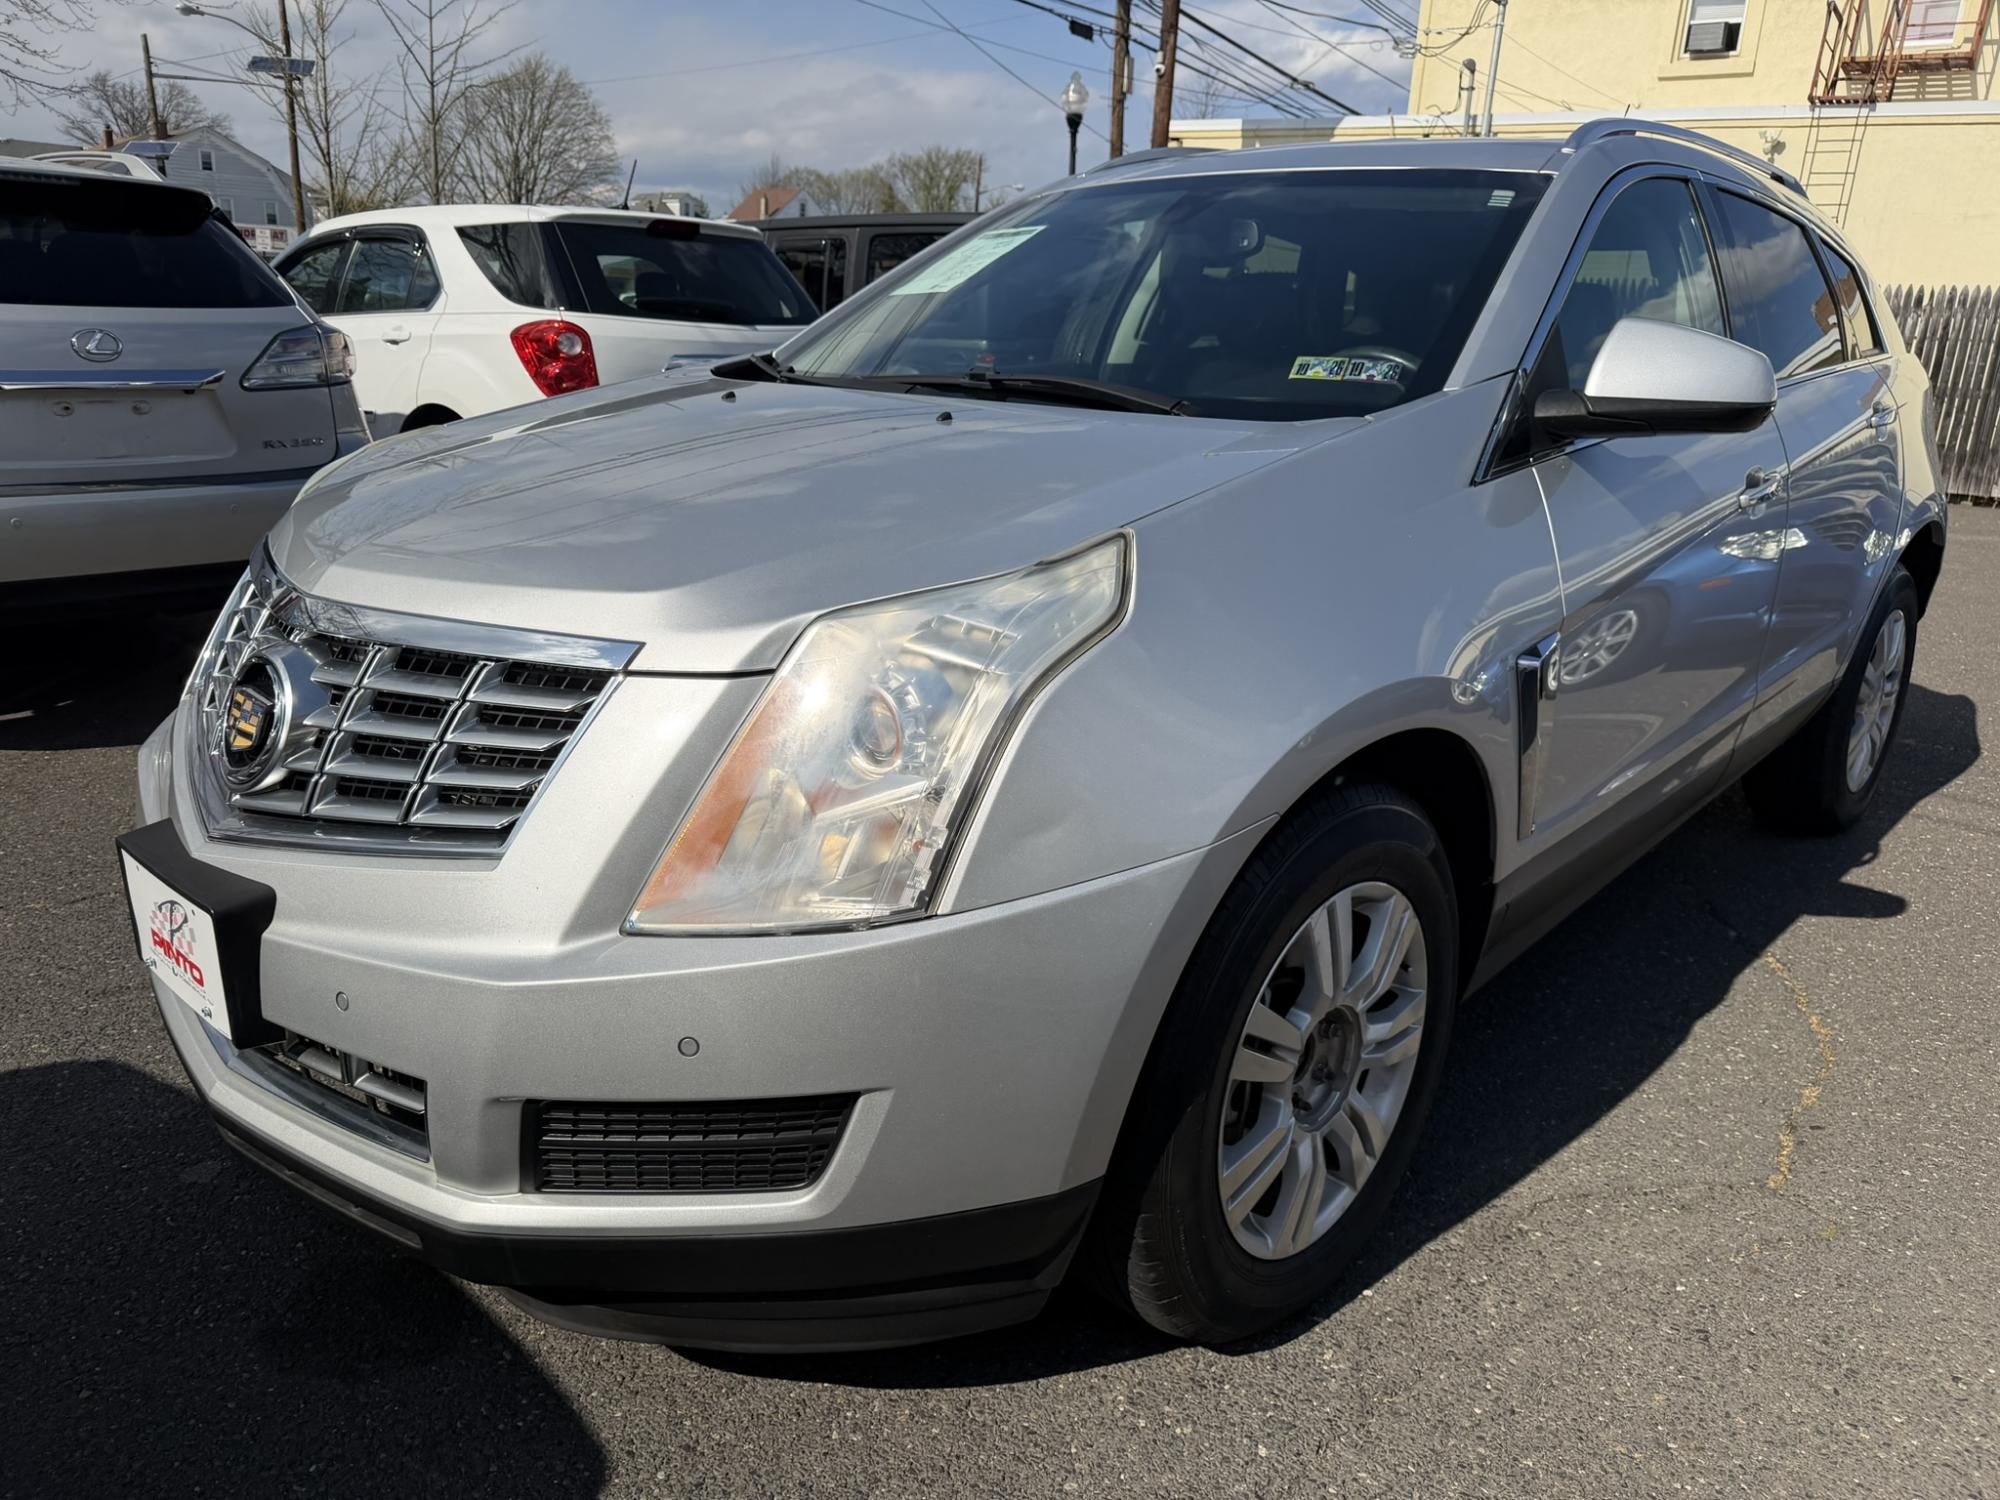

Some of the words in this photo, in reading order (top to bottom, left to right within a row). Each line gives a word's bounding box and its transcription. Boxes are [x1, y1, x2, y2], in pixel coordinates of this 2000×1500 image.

[1328, 360, 1345, 376] 26
[1383, 363, 1400, 380] 26
[150, 927, 204, 987] PINTO
